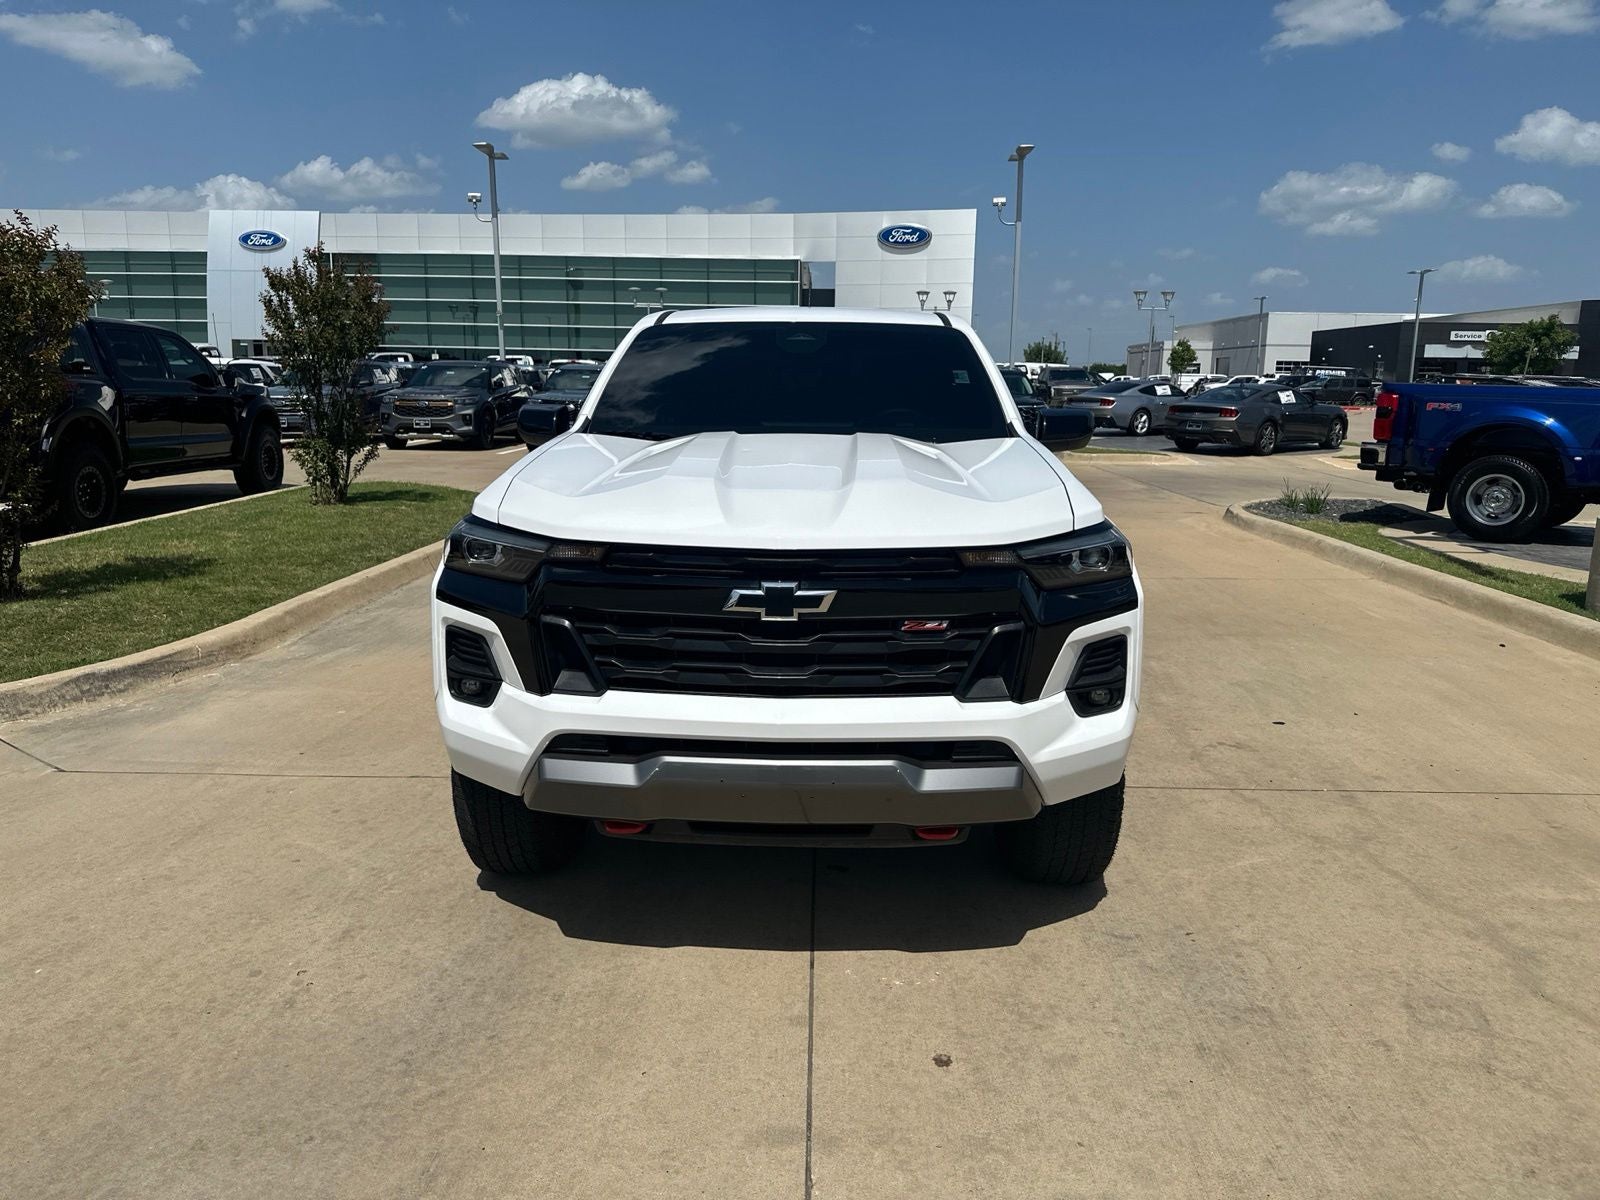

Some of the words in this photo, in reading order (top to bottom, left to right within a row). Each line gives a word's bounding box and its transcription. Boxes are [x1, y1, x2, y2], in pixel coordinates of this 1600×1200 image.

[247, 233, 274, 245] Ford
[889, 229, 919, 242] Ford
[1315, 369, 1346, 377] PREMIER
[1426, 402, 1462, 411] FX4
